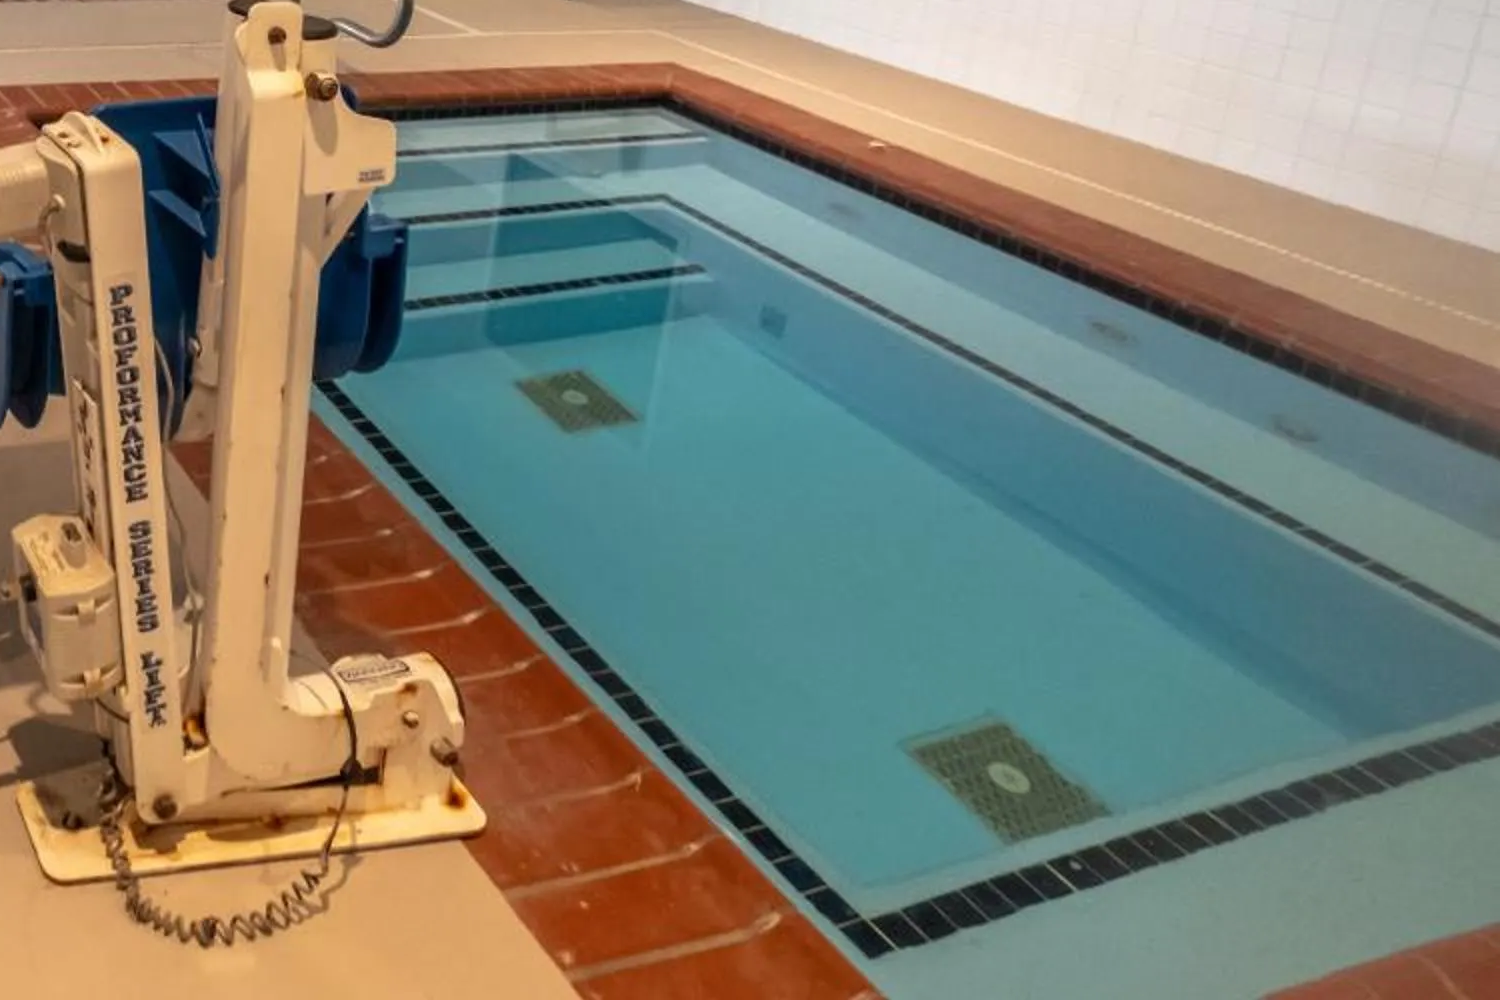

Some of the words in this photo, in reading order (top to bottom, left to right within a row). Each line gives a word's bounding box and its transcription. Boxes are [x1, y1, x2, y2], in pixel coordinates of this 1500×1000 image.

[110, 284, 148, 504] PROFORMANCE
[128, 520, 159, 633] SERIES
[140, 651, 167, 728] LIFT
